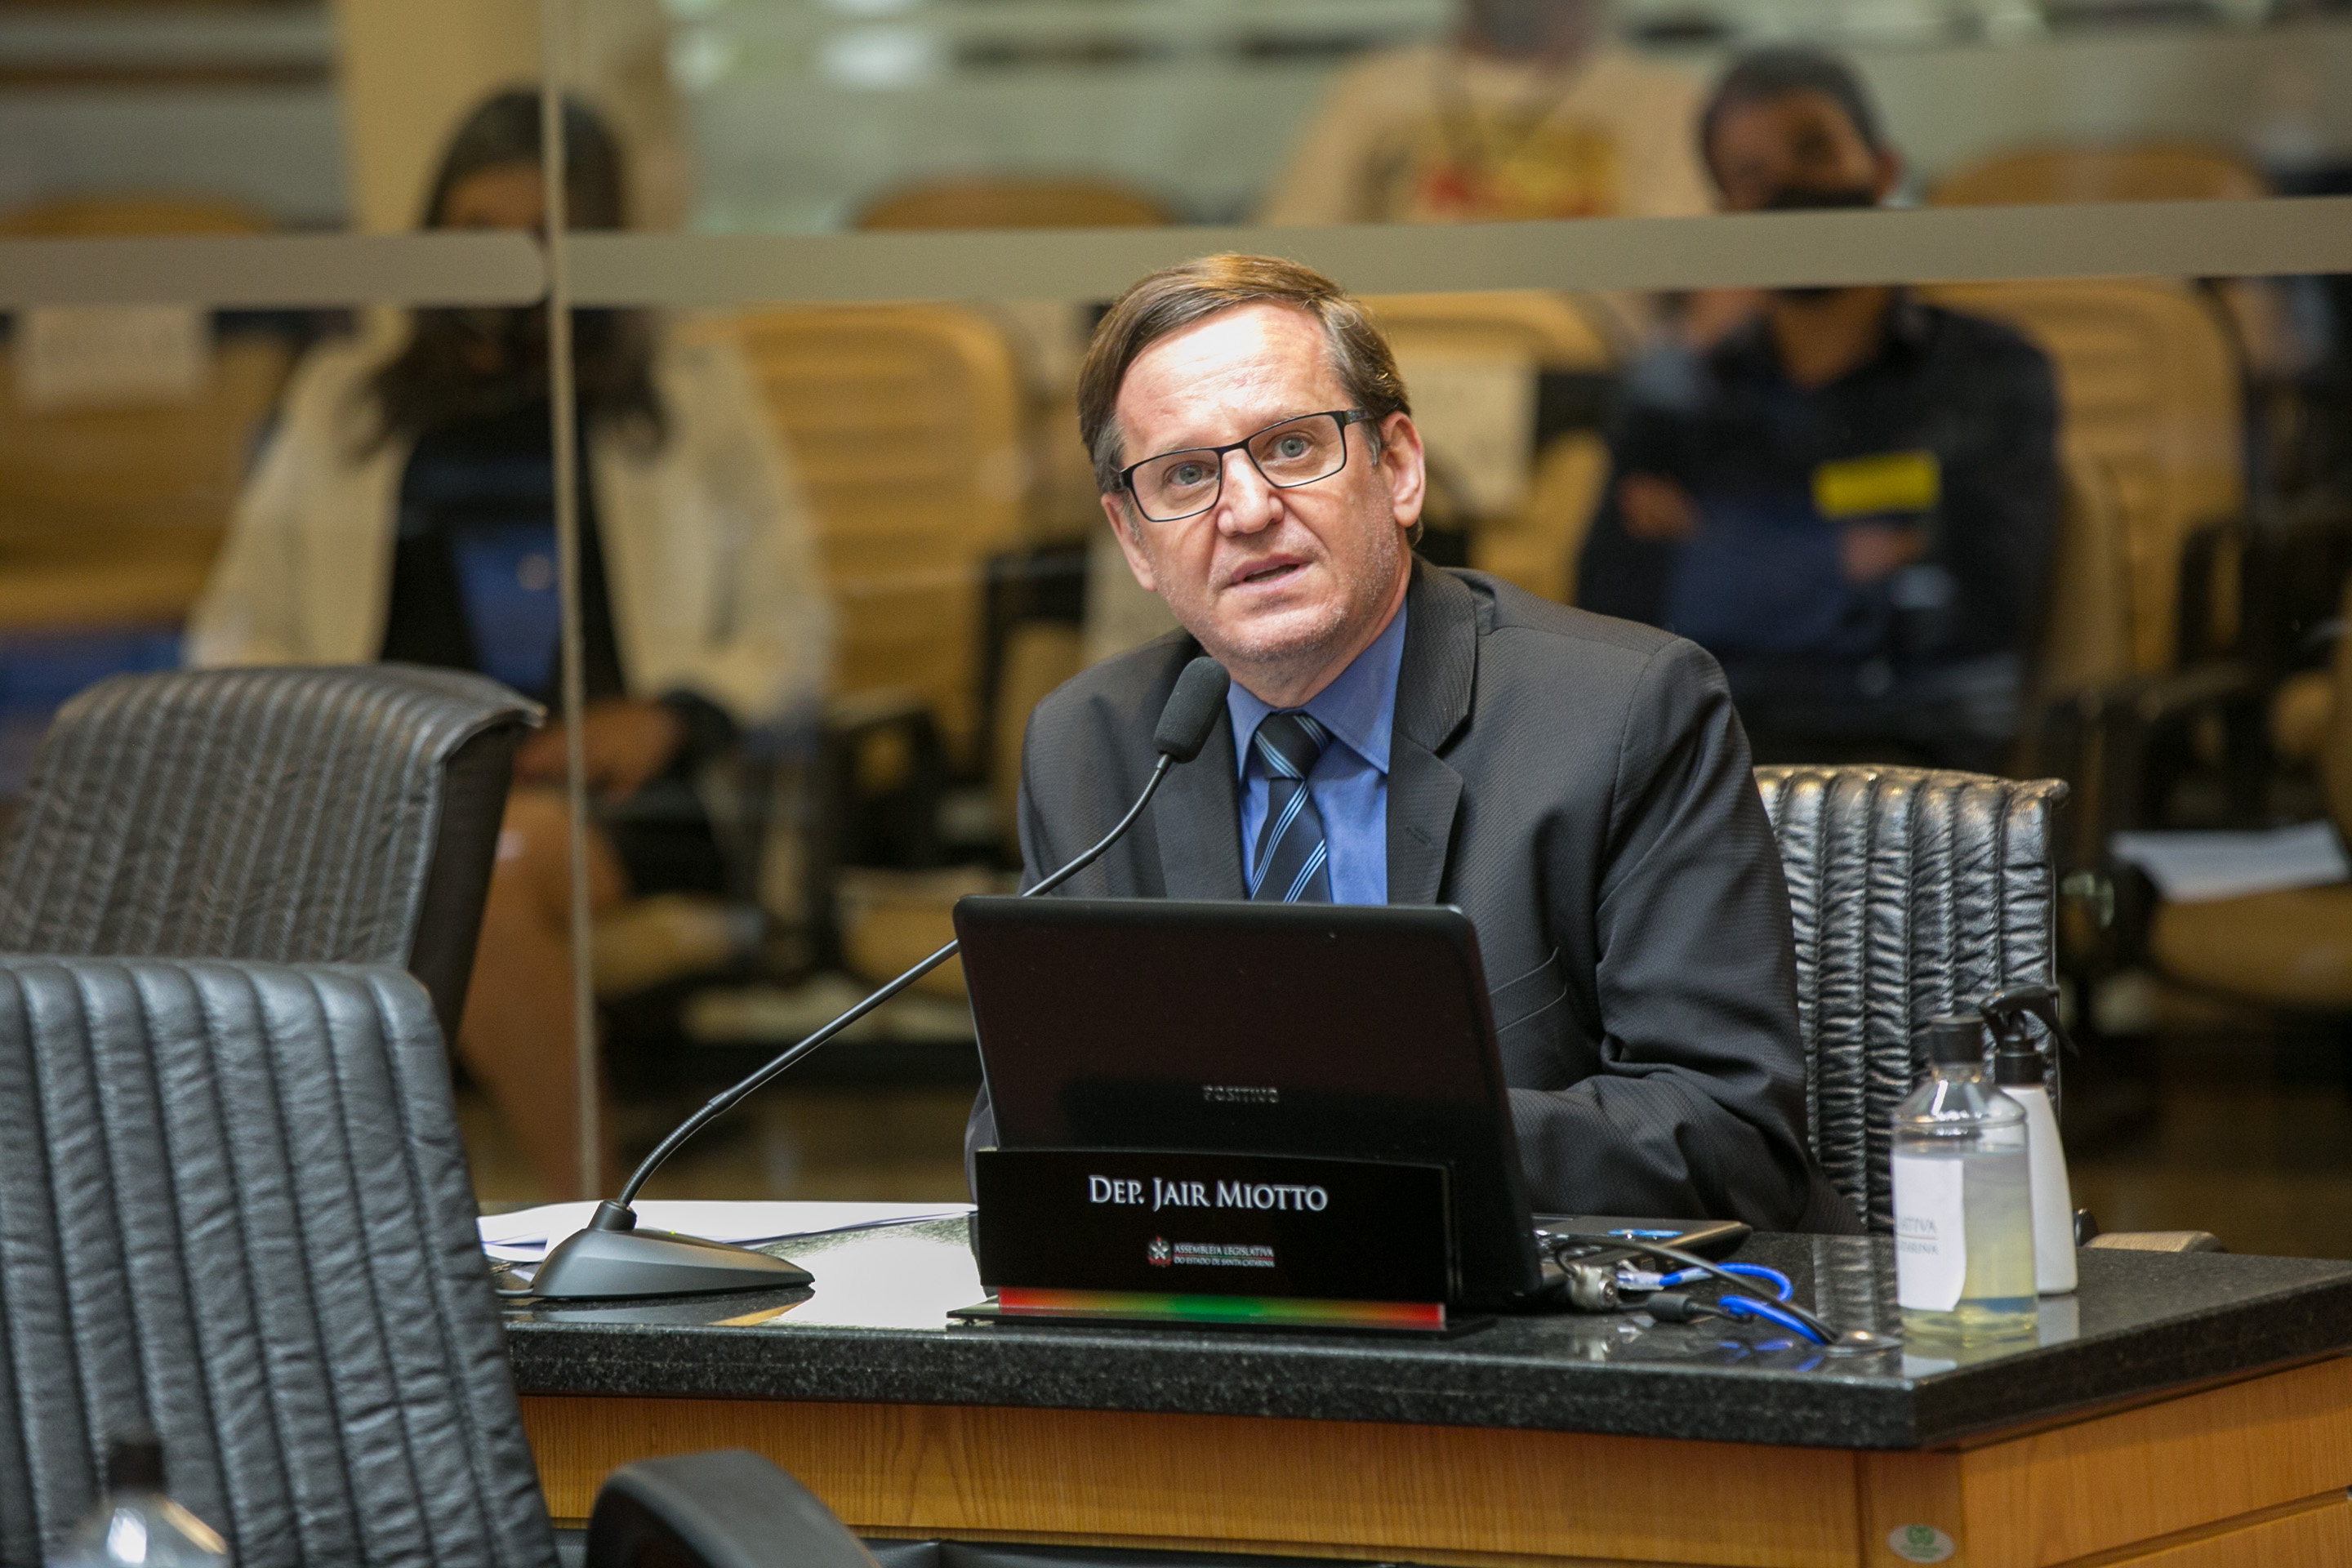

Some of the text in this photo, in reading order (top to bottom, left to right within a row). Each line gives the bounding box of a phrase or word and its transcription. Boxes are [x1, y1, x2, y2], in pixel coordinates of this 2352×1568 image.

[1203, 1085, 1279, 1103] POSITIVO
[1174, 1243, 1274, 1258] ASSEMBLEIA LEGISLATIVA
[1174, 1256, 1275, 1268] DO ESTADO DE SANTA CATARINA
